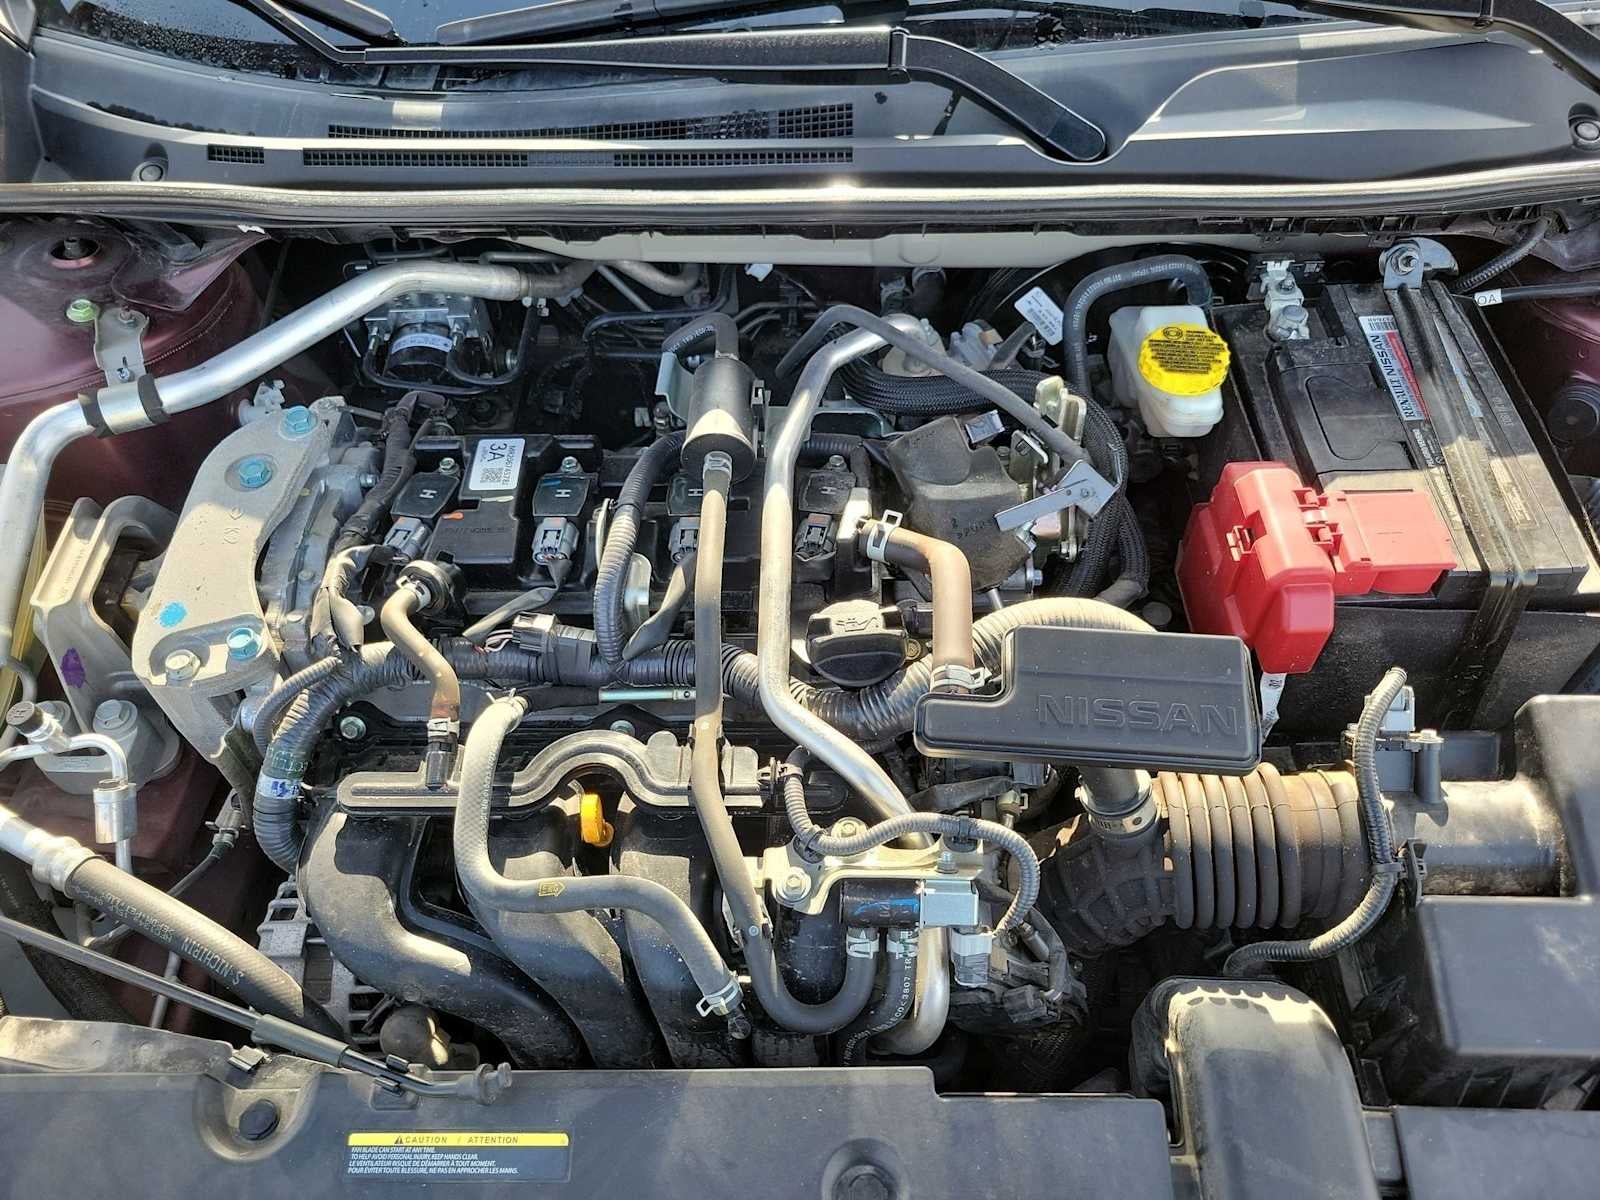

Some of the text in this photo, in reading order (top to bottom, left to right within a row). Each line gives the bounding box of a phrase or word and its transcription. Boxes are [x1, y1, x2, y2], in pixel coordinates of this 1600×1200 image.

[1370, 335, 1395, 376] NISSAN
[1390, 376, 1416, 418] RENAULT
[487, 443, 508, 462] 3A
[1038, 694, 1239, 737] NISSAN
[405, 1136, 448, 1144] CAUTION
[467, 1136, 519, 1144] ATTENTION
